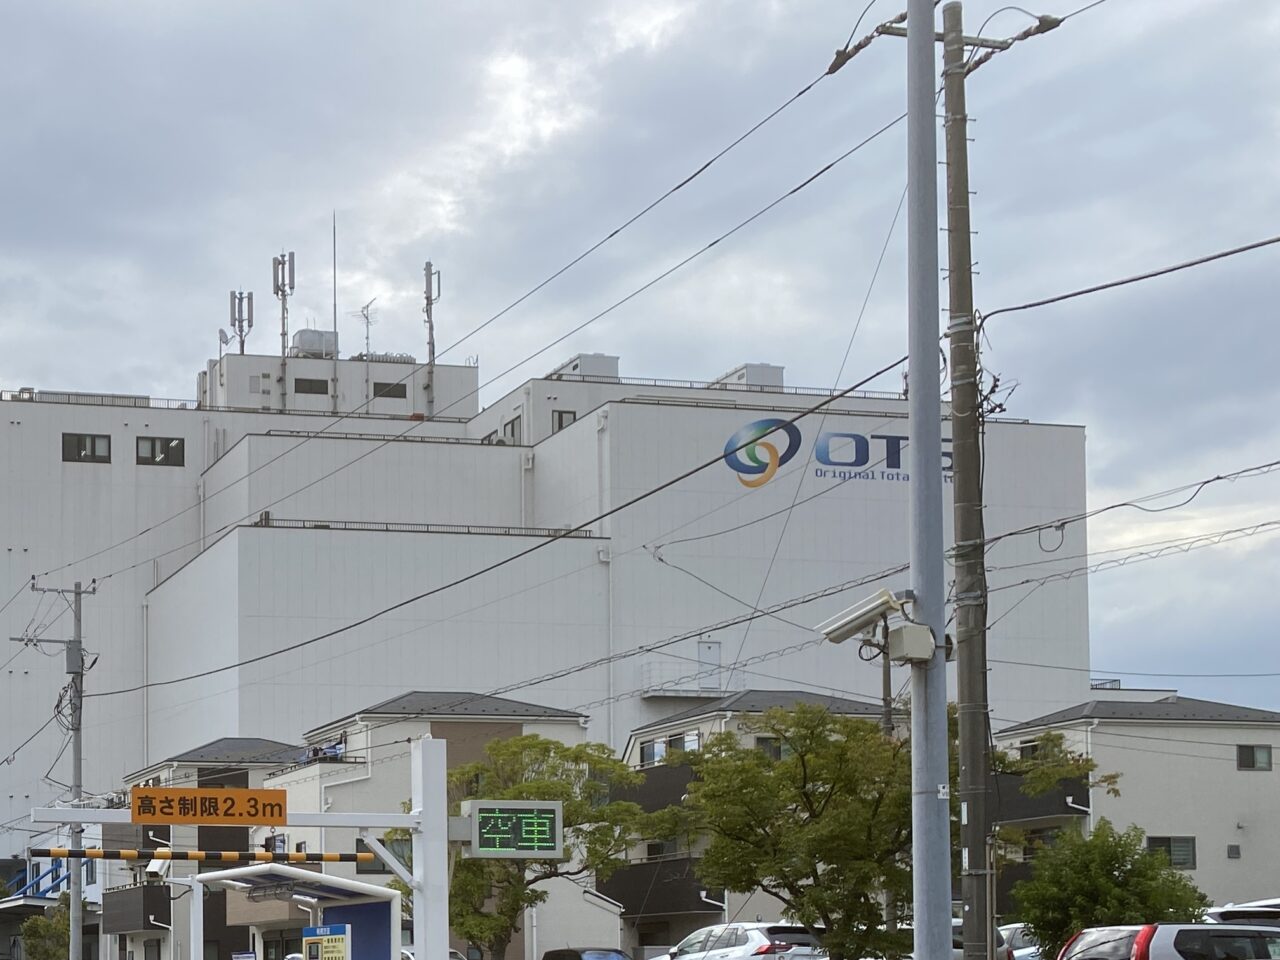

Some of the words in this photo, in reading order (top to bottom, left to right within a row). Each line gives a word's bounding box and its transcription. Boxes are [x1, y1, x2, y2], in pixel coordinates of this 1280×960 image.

[815, 468, 876, 481] Original
[880, 470, 910, 482] Tota
[137, 795, 283, 818] 高さ制限2.3m
[479, 808, 554, 851] 空車
